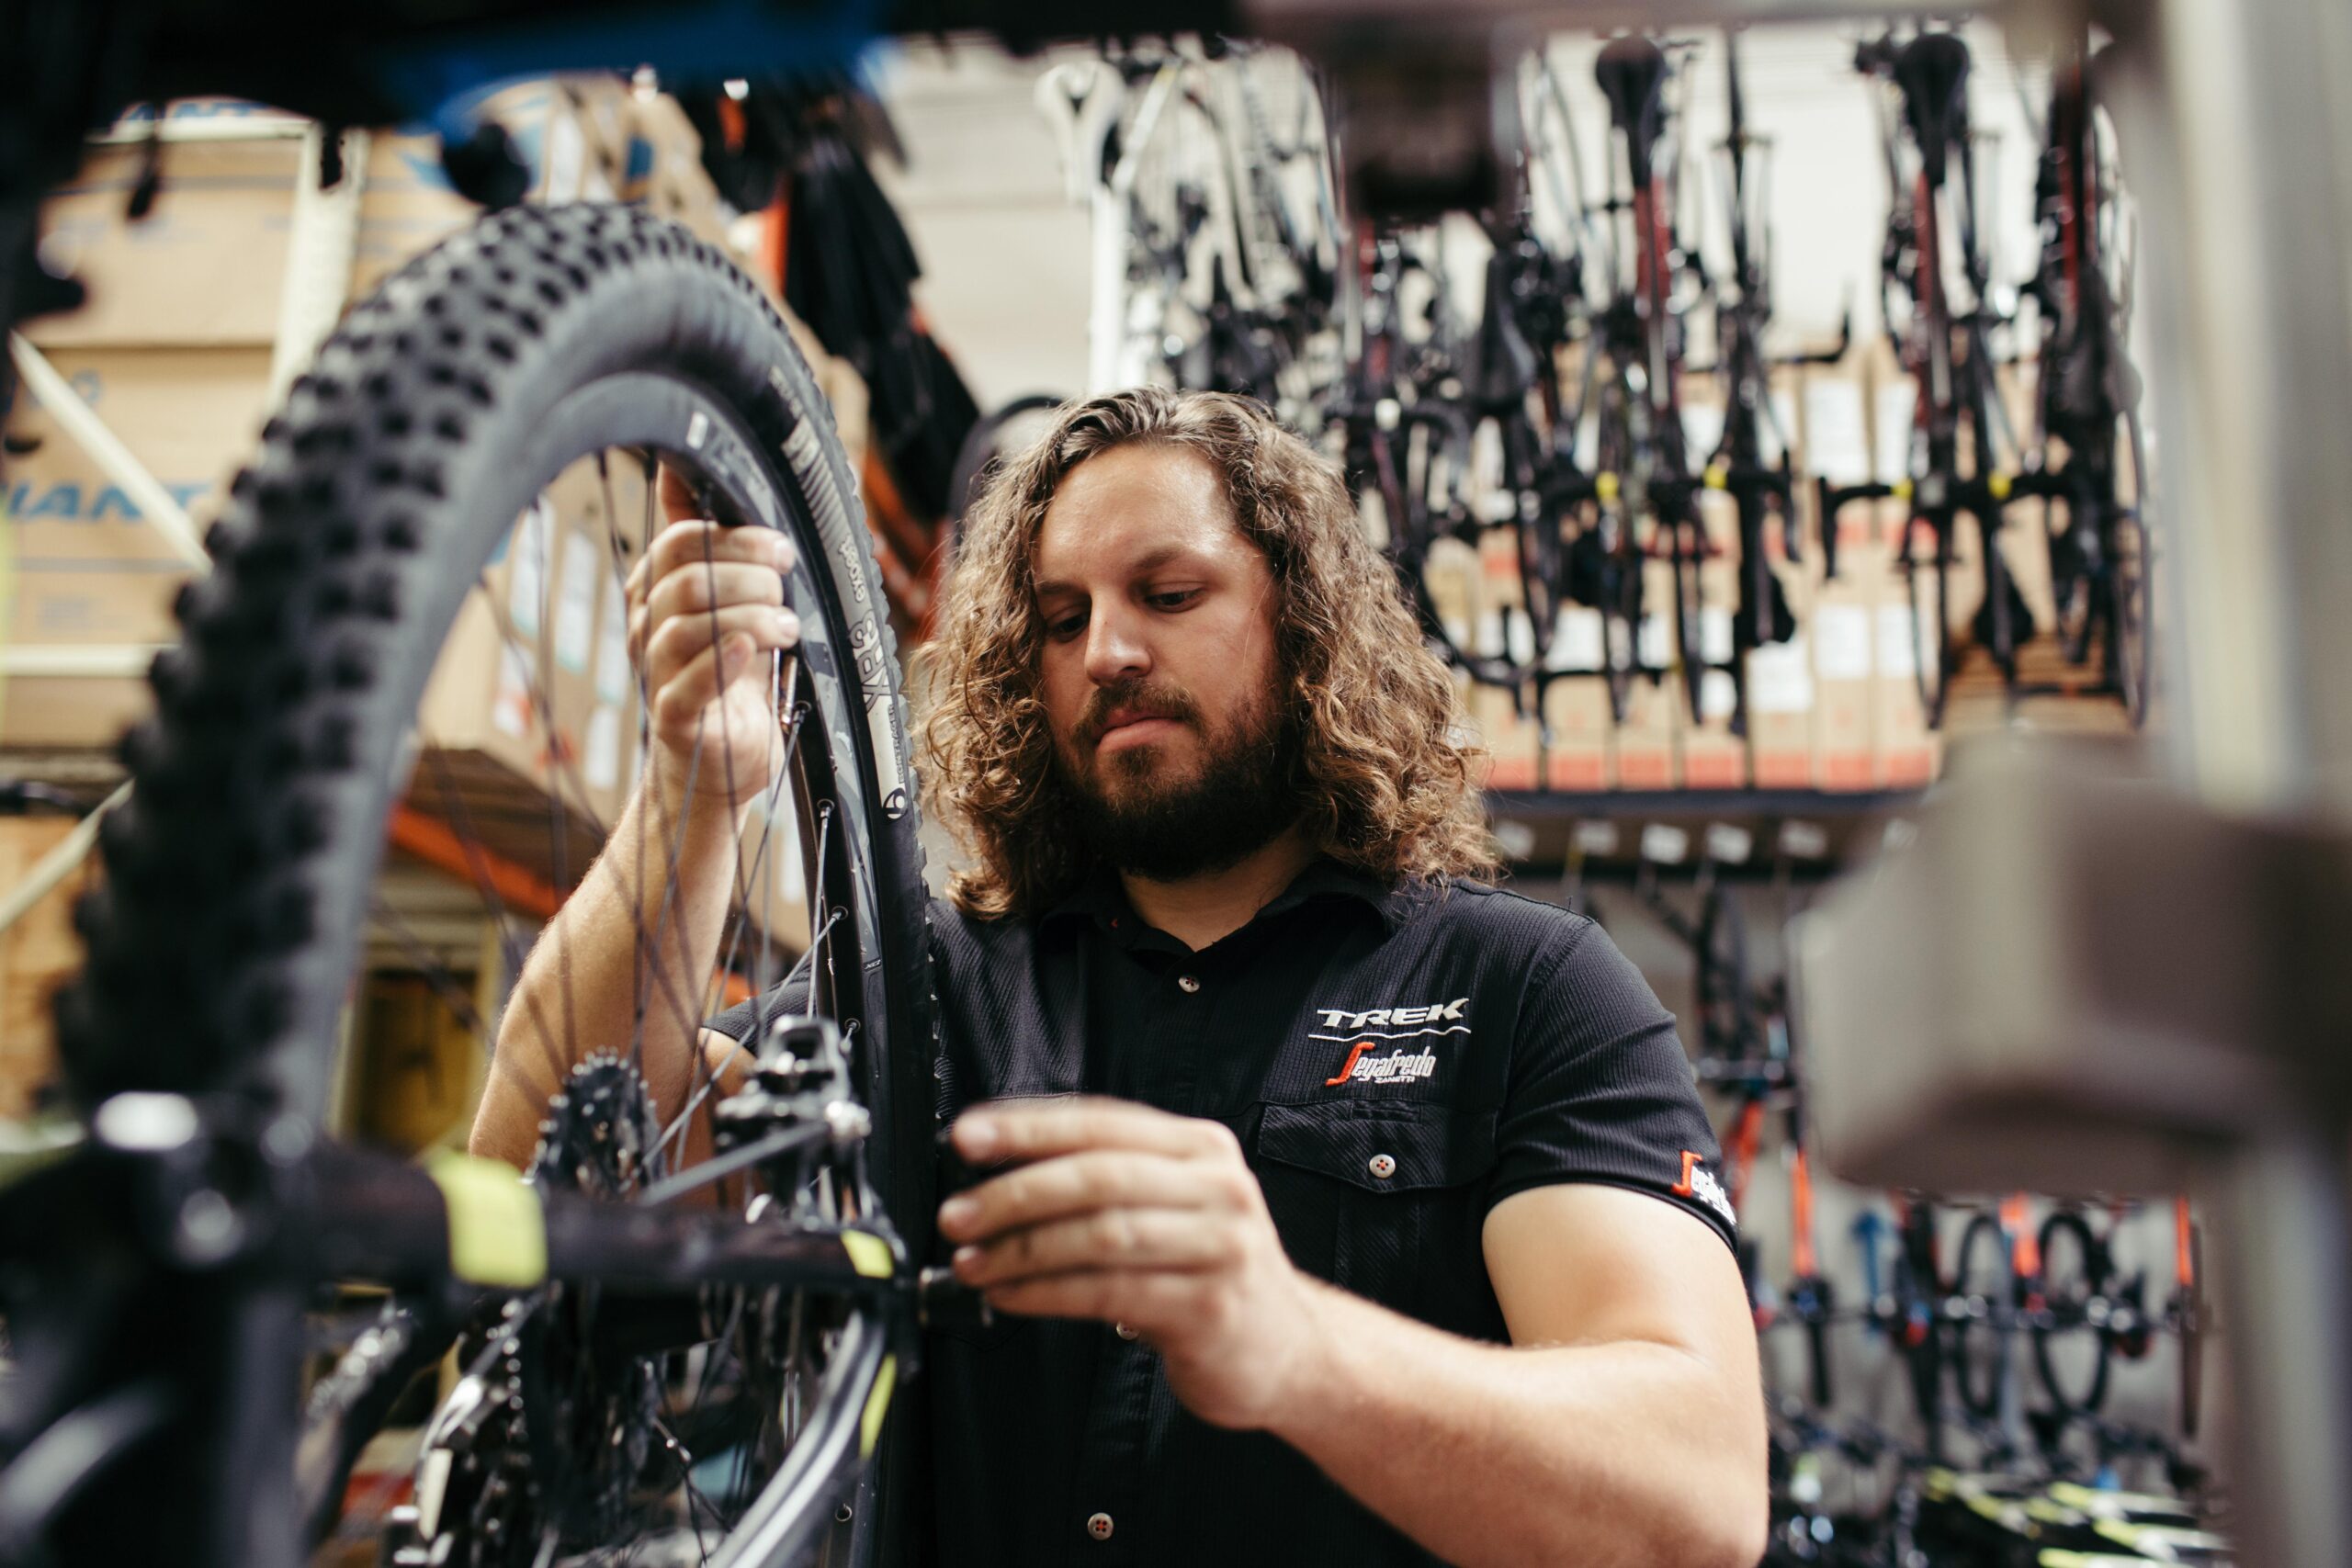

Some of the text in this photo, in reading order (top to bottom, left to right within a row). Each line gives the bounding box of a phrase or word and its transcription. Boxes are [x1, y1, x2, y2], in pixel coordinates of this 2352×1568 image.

[7, 481, 213, 520] IANT
[838, 533, 892, 715] XR3 expert
[887, 703, 905, 784] BONTRAGER
[1317, 998, 1470, 1029] TREK
[1325, 1042, 1437, 1087] Segafredo
